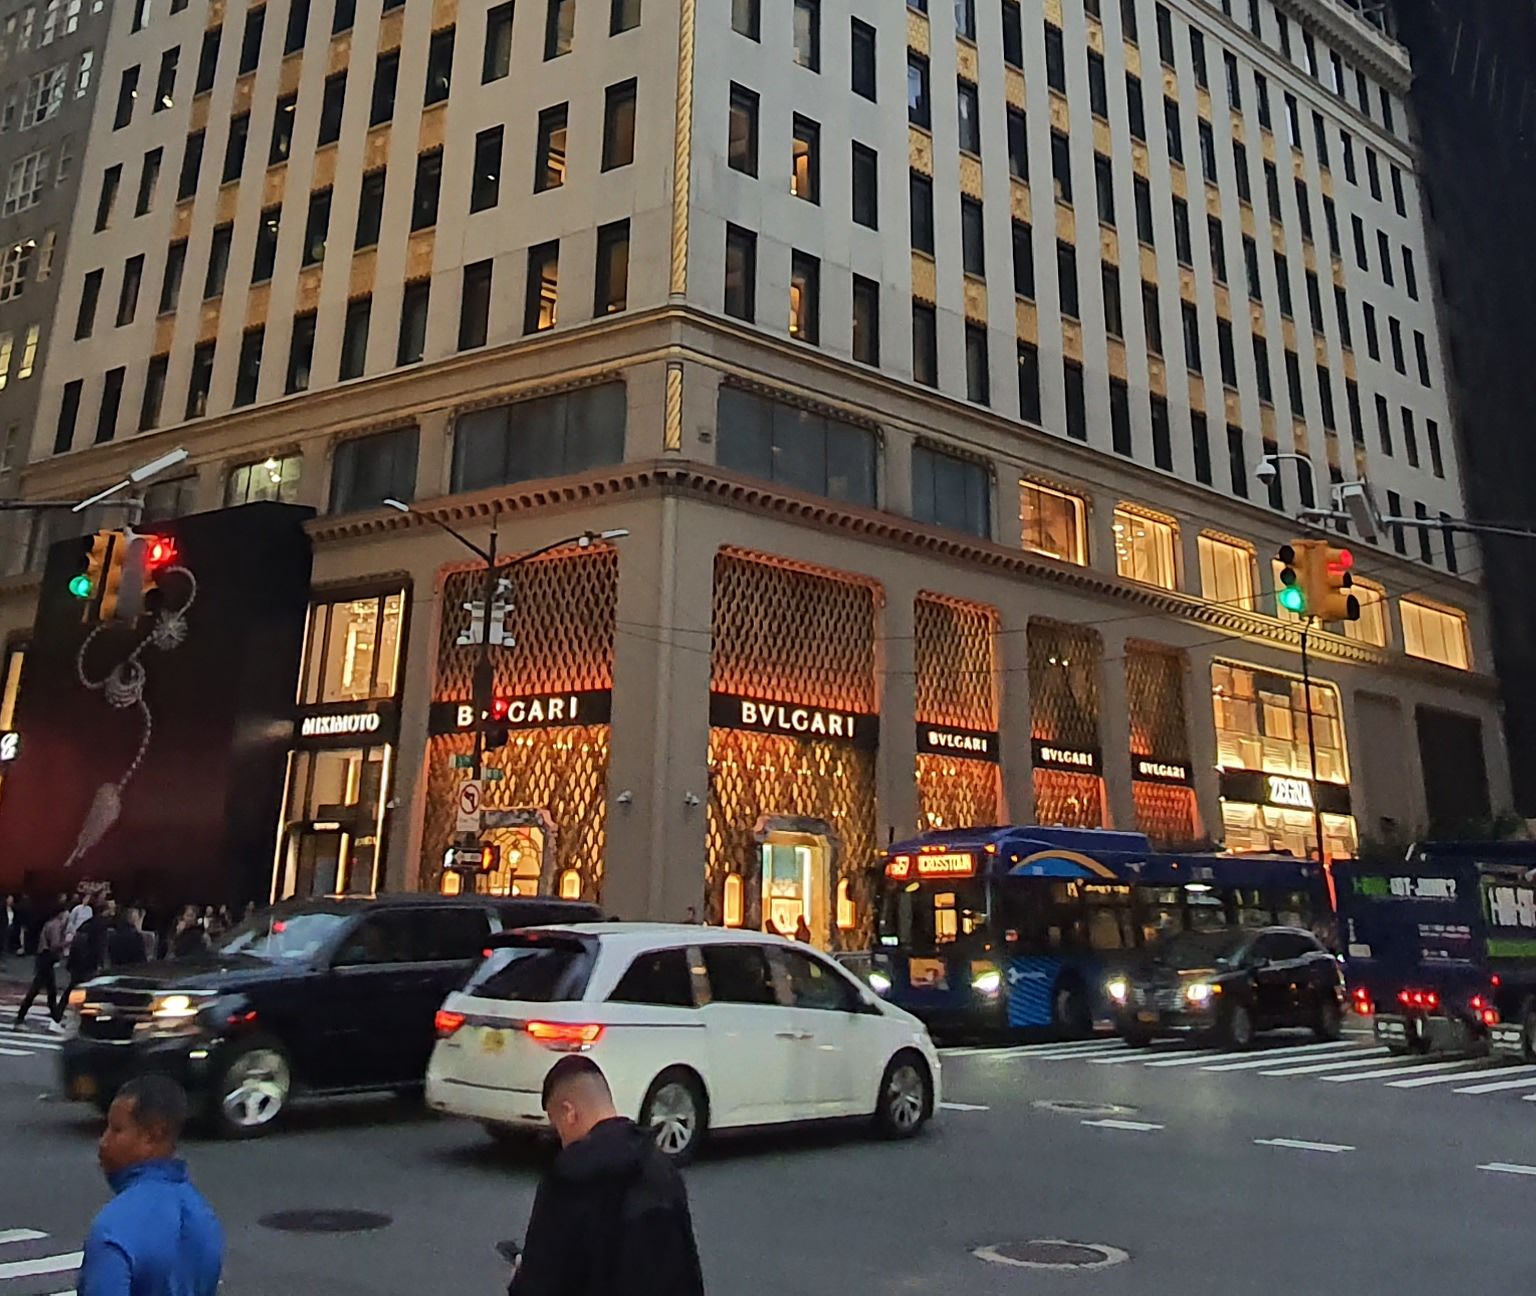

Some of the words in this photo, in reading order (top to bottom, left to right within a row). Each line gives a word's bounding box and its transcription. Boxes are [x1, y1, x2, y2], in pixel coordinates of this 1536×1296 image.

[301, 712, 381, 736] MIKIMOTO
[457, 696, 578, 728] BGARI
[741, 701, 855, 738] BVLGARI
[927, 731, 988, 753] BVLGARI
[1040, 747, 1093, 767] BVLGARI
[1139, 761, 1185, 780] BVLGARI
[1268, 775, 1314, 808] ZEGNA
